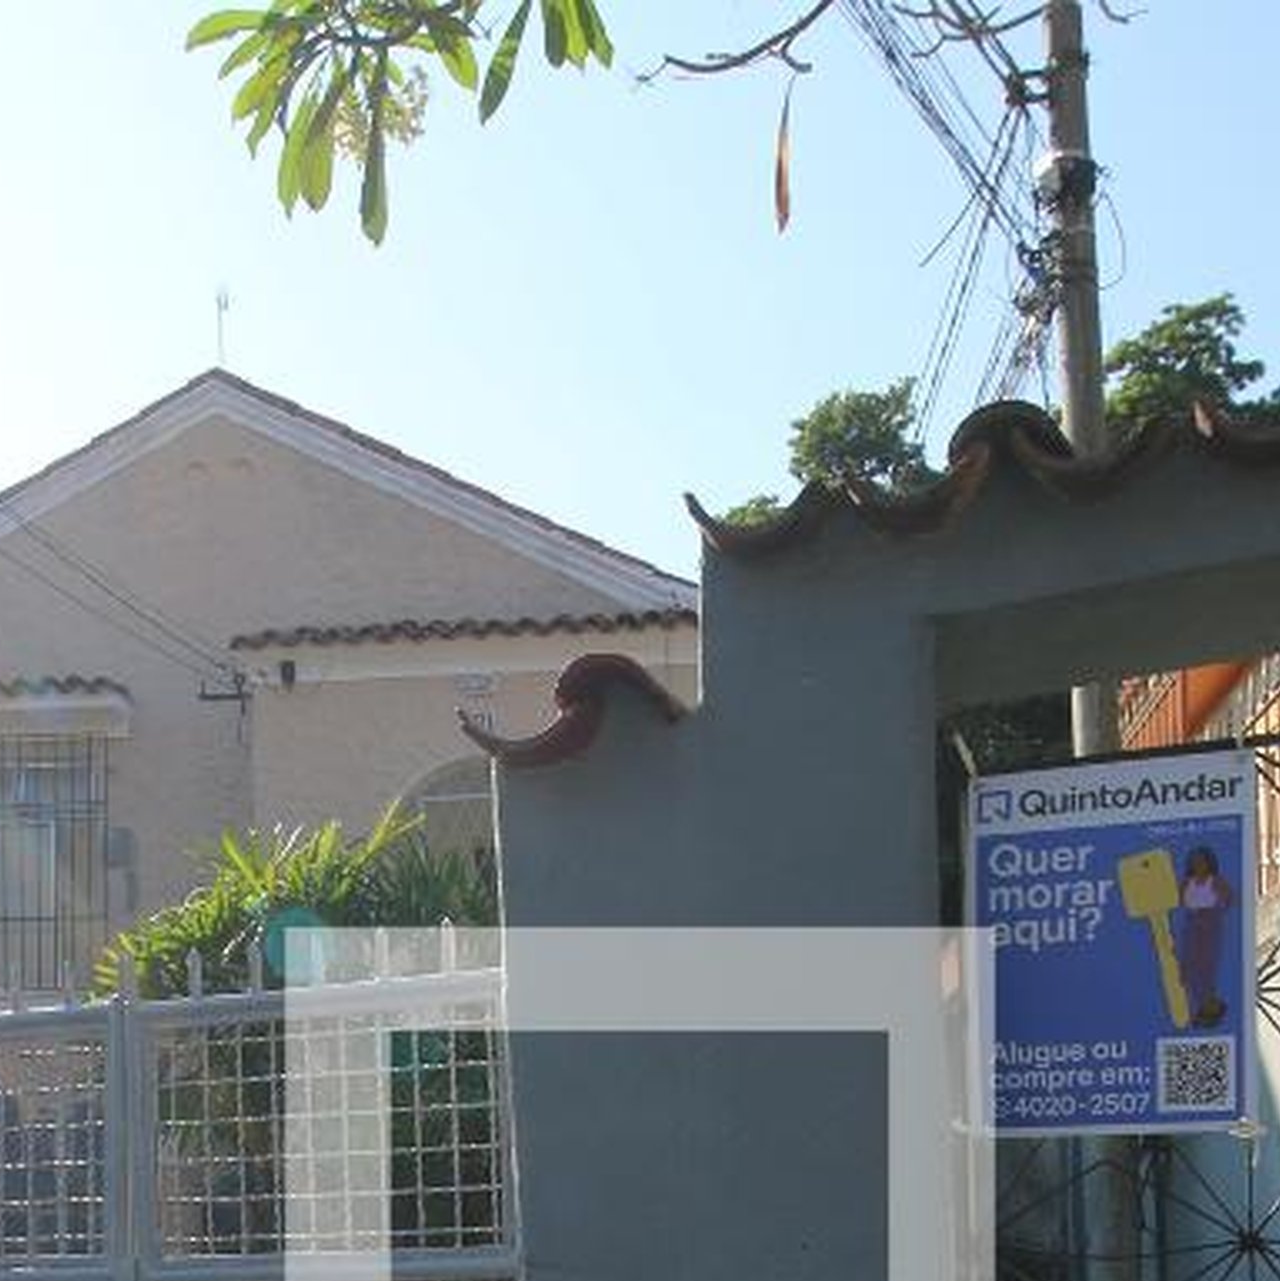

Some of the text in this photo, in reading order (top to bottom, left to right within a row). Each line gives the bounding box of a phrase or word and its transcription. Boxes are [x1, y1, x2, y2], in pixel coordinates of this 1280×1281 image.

[1019, 774, 1243, 817] QuintoAndar
[988, 843, 1095, 878] Quer
[988, 877, 1114, 912] morar
[990, 908, 1102, 951] aqui?
[990, 1040, 1127, 1069] Alugue ou
[991, 1065, 1151, 1093] compre em:
